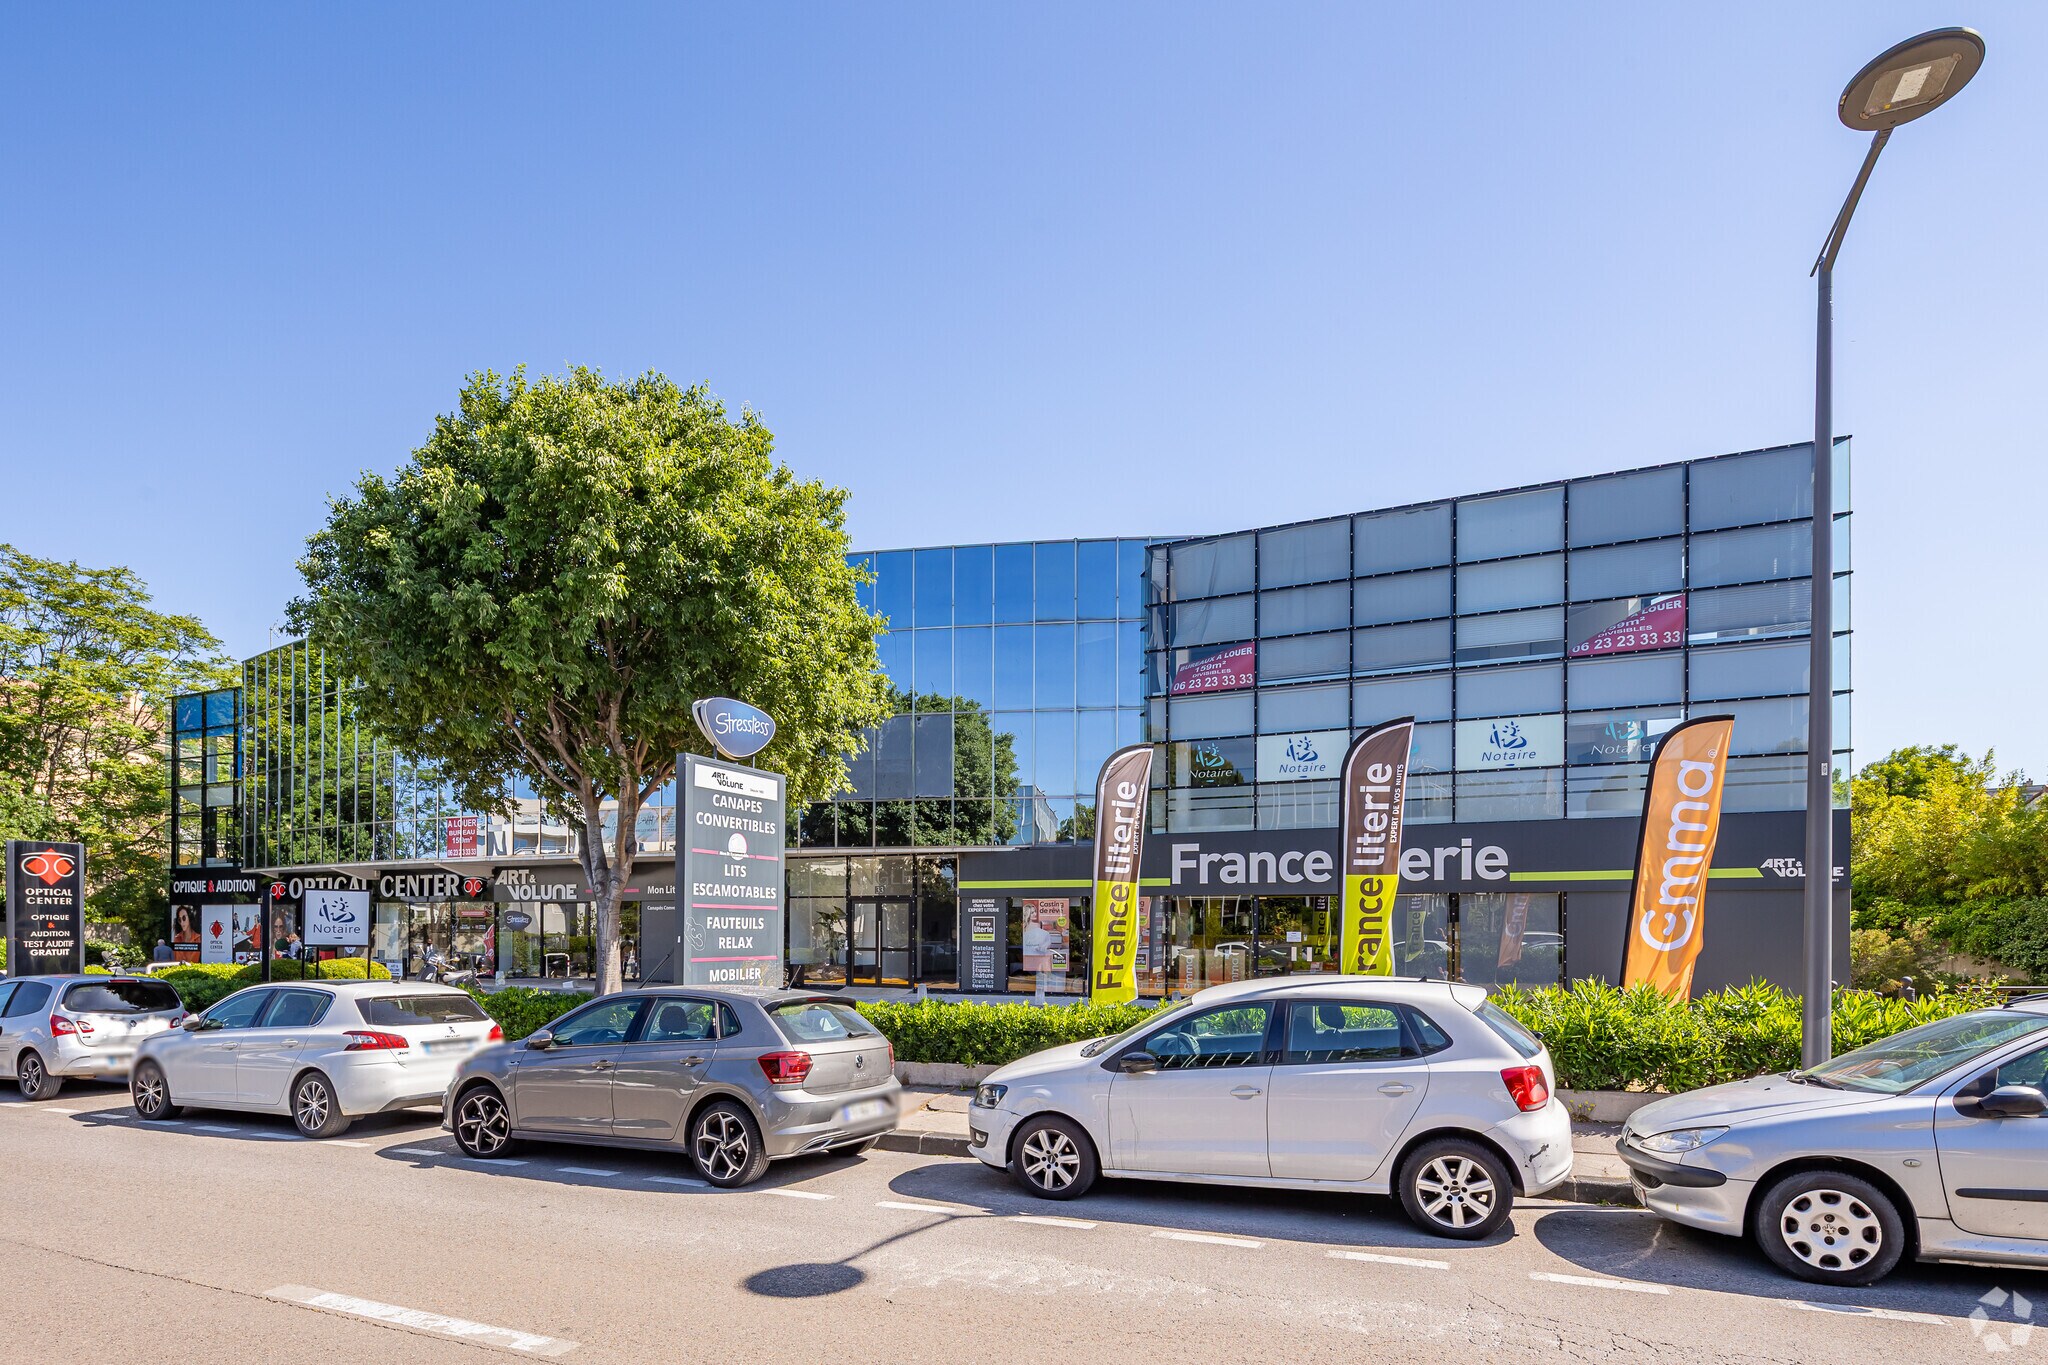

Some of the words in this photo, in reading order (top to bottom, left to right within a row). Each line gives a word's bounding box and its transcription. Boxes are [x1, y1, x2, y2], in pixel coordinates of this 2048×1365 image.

[1642, 600, 1682, 614] LOUER
[1597, 625, 1653, 638] DIVISIBLES
[1572, 642, 1589, 653] 06
[1594, 637, 1612, 650] 23
[1617, 634, 1635, 647] 23
[1640, 633, 1658, 645] 33
[1663, 630, 1680, 643] 33
[1180, 656, 1214, 672] BUREAUX
[1224, 647, 1253, 659] LOUER
[1194, 660, 1227, 673] 159m²
[1192, 668, 1232, 679] DIVISIBLES
[1173, 682, 1186, 691] 06
[1188, 678, 1202, 689] 23
[1204, 676, 1219, 687] 23
[1222, 675, 1236, 686] 33
[1239, 673, 1253, 684] 33
[715, 713, 769, 736] Stressless
[1480, 749, 1537, 761] Notaire
[1590, 743, 1651, 755] Notaire
[1190, 768, 1233, 779] Notaire
[1278, 762, 1326, 774] Notaire
[1396, 764, 1404, 789] NUITS
[713, 794, 763, 814] CANAPES
[1393, 805, 1400, 816] DE
[1353, 762, 1393, 866] literie
[453, 818, 477, 828] LOUER
[696, 811, 776, 834] CONVERTIBLES
[1104, 781, 1137, 874] literie
[1134, 820, 1140, 829] DE
[1389, 819, 1398, 843] EXPERT
[1172, 843, 1333, 885] France
[1400, 838, 1509, 882] erie
[1640, 759, 1715, 952] emma
[724, 864, 747, 878] LITS
[1773, 867, 1844, 877] VOLE
[25, 888, 73, 896] OPTICAL
[173, 880, 206, 893] OPTIQUE
[207, 880, 215, 893] &
[216, 879, 256, 893] AUDITION
[380, 874, 460, 898] CENTER
[647, 885, 664, 894] Mon
[693, 883, 777, 899] ESCAMOTABLES
[875, 886, 885, 894] 33
[26, 897, 72, 905] CENTER
[313, 924, 361, 934] Notaire
[707, 917, 764, 930] FAUTEUILS
[1349, 877, 1384, 976] rance
[23, 940, 44, 948] TEST
[718, 936, 753, 949] RELAX
[1096, 884, 1130, 990] France
[709, 968, 762, 982] MOBILIER
[1184, 957, 1193, 991] emma
[1231, 958, 1240, 984] mma
